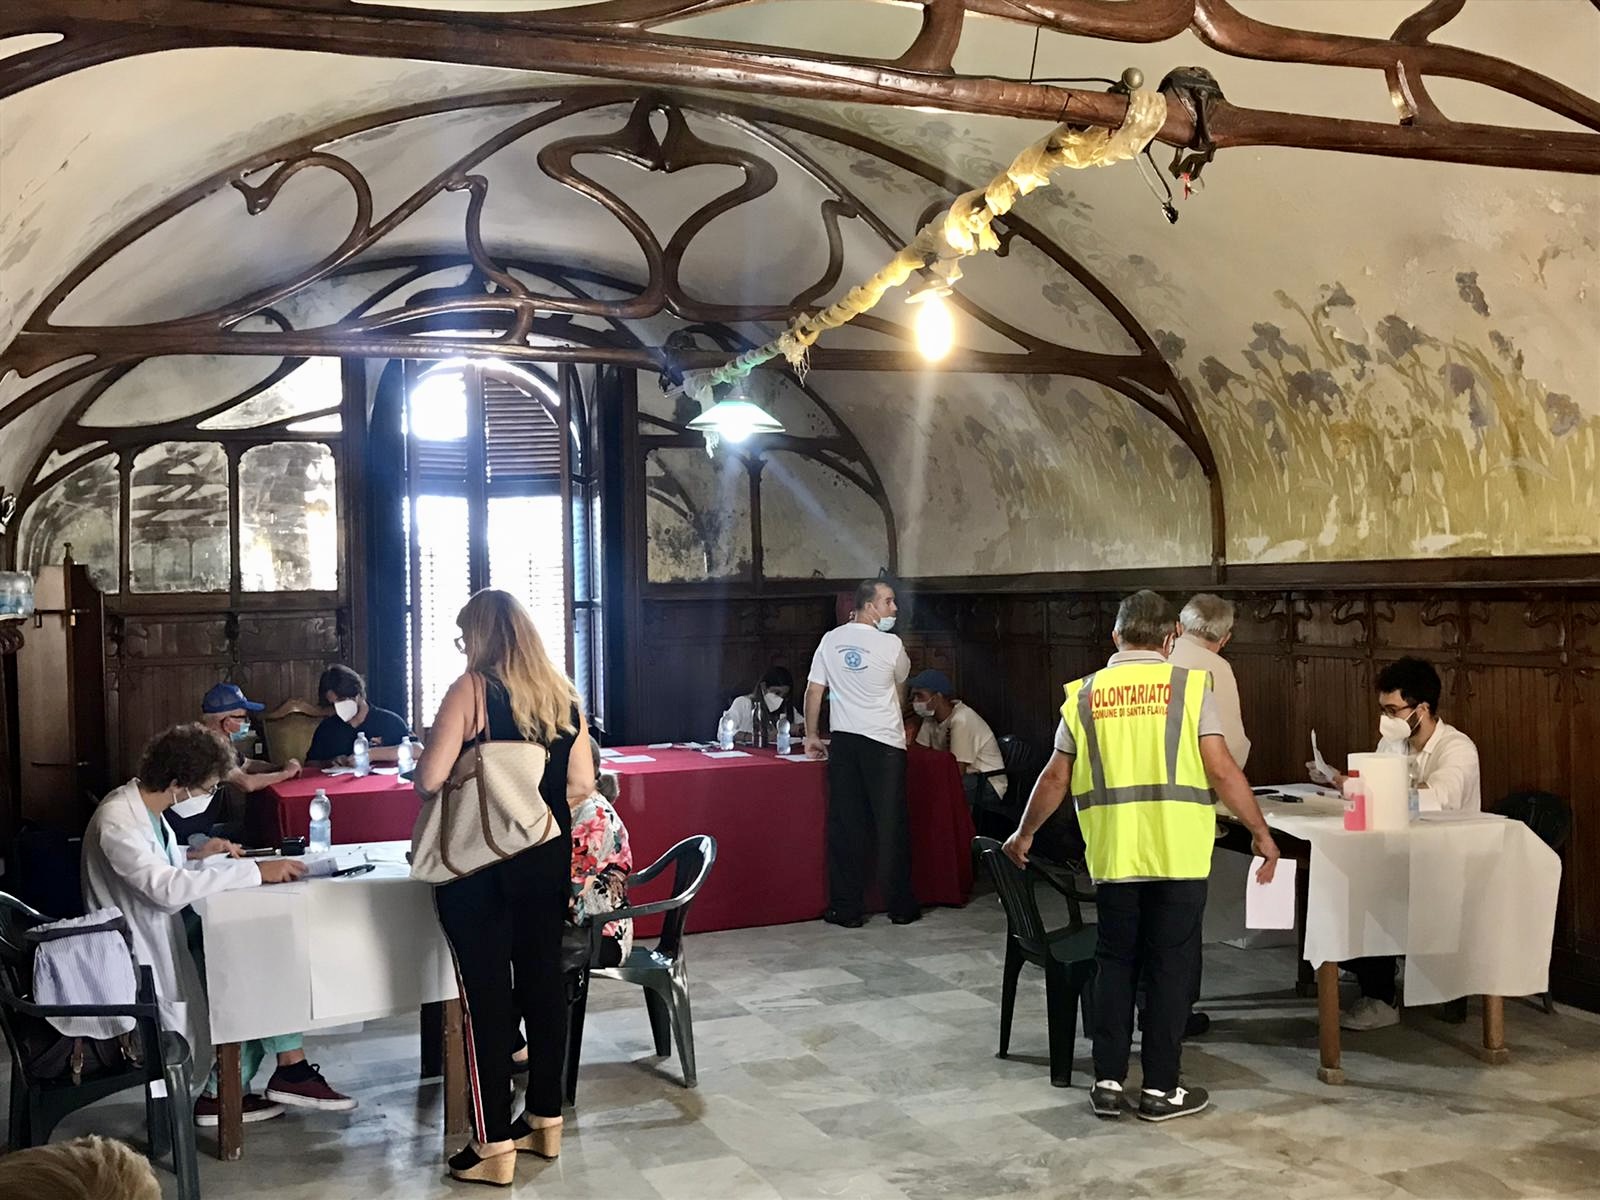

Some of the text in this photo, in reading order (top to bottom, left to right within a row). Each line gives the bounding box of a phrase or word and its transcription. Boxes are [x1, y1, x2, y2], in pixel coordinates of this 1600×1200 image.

[1088, 684, 1172, 709] VOLONTARIATO
[1092, 709, 1118, 720] COMUNE
[1119, 708, 1126, 718] DI
[1126, 706, 1146, 716] SANTA
